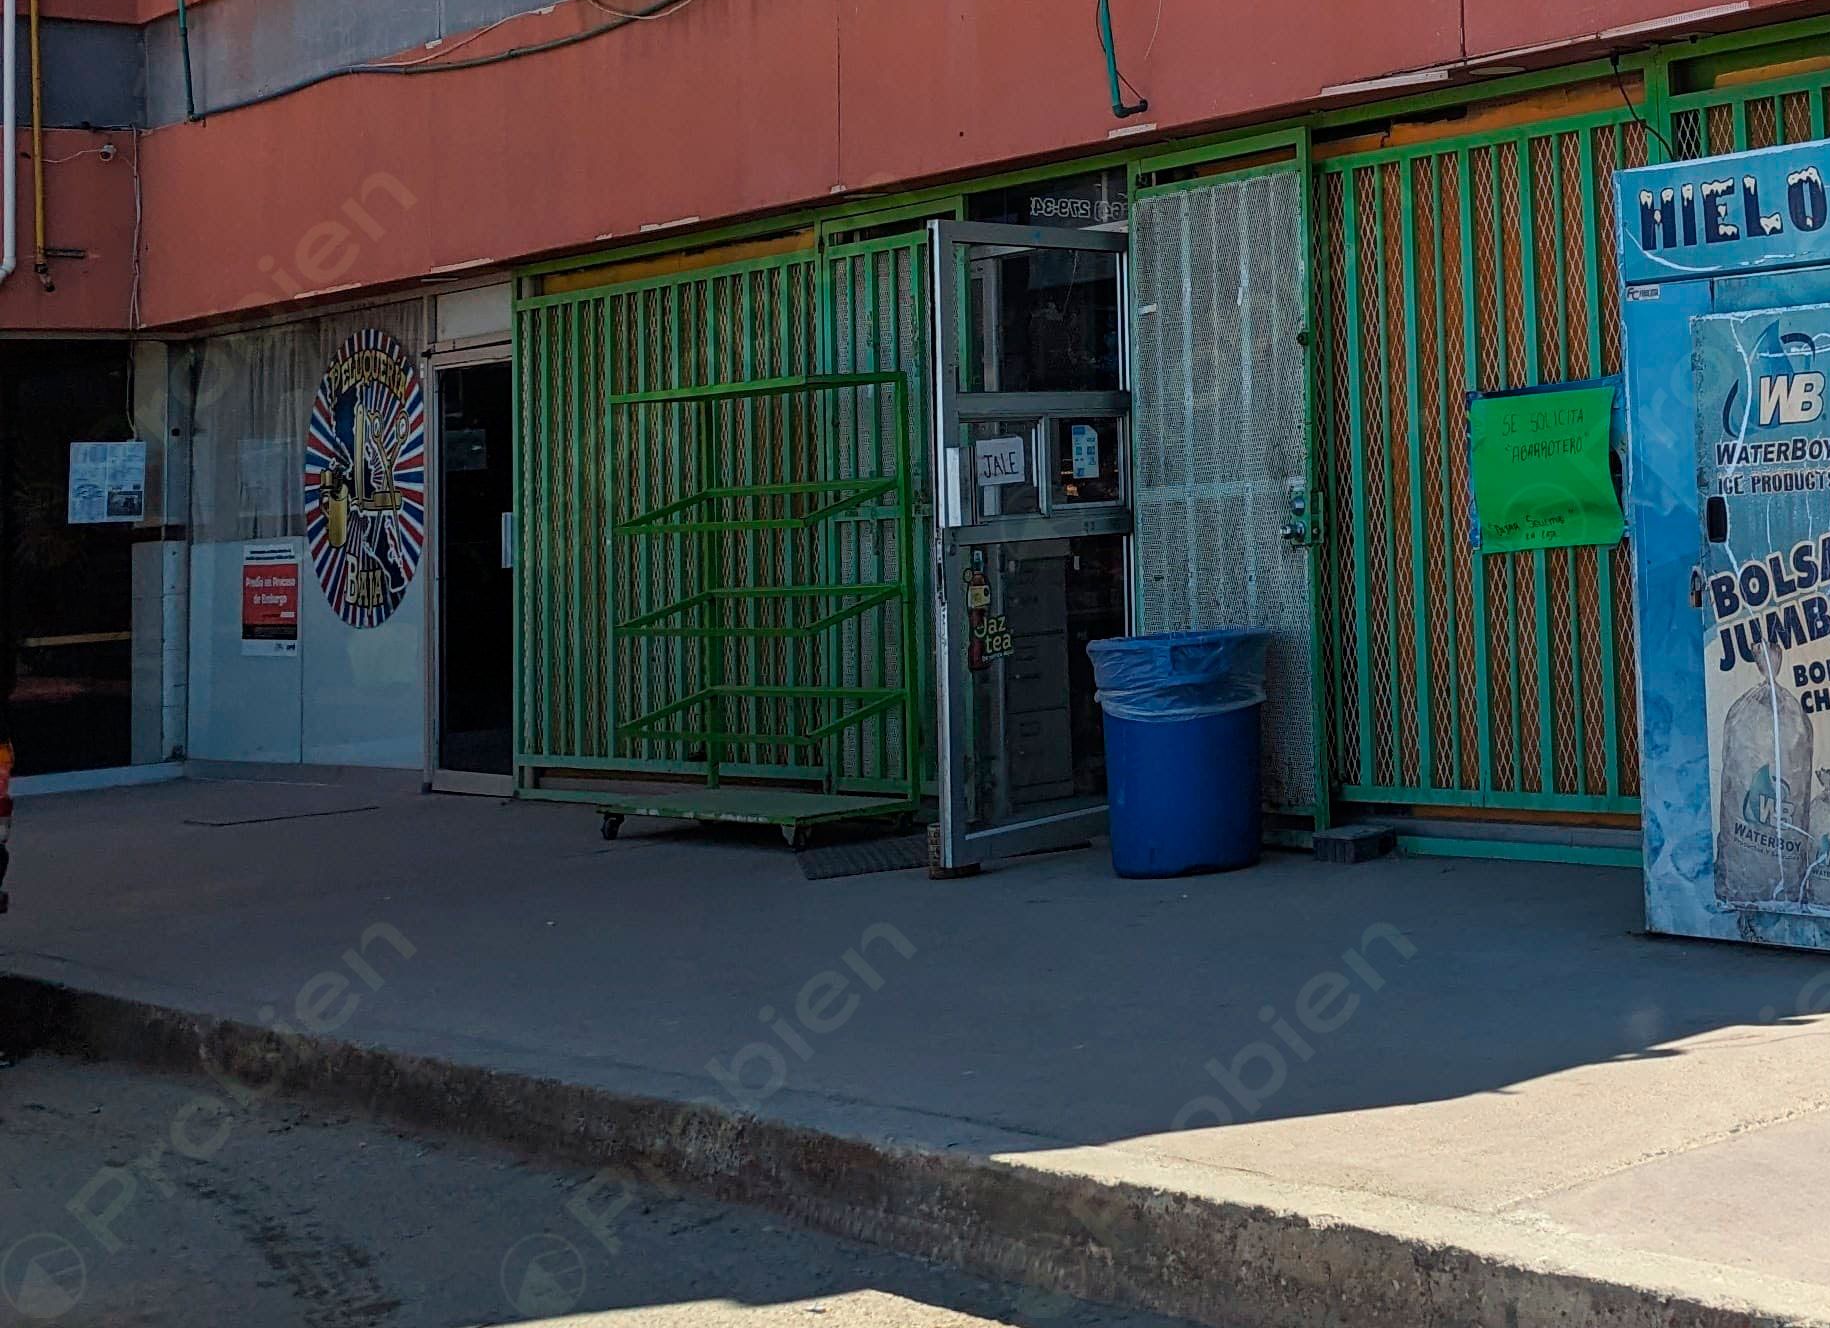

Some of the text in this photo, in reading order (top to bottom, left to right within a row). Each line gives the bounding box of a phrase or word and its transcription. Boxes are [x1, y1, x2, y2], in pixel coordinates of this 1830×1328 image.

[1639, 166, 1828, 250] HIELO
[1759, 371, 1827, 425] WB
[1502, 408, 1585, 437] SE SOLICITA
[984, 451, 1019, 478] JALE
[1718, 474, 1744, 495] ICE
[985, 633, 1012, 654] tea
